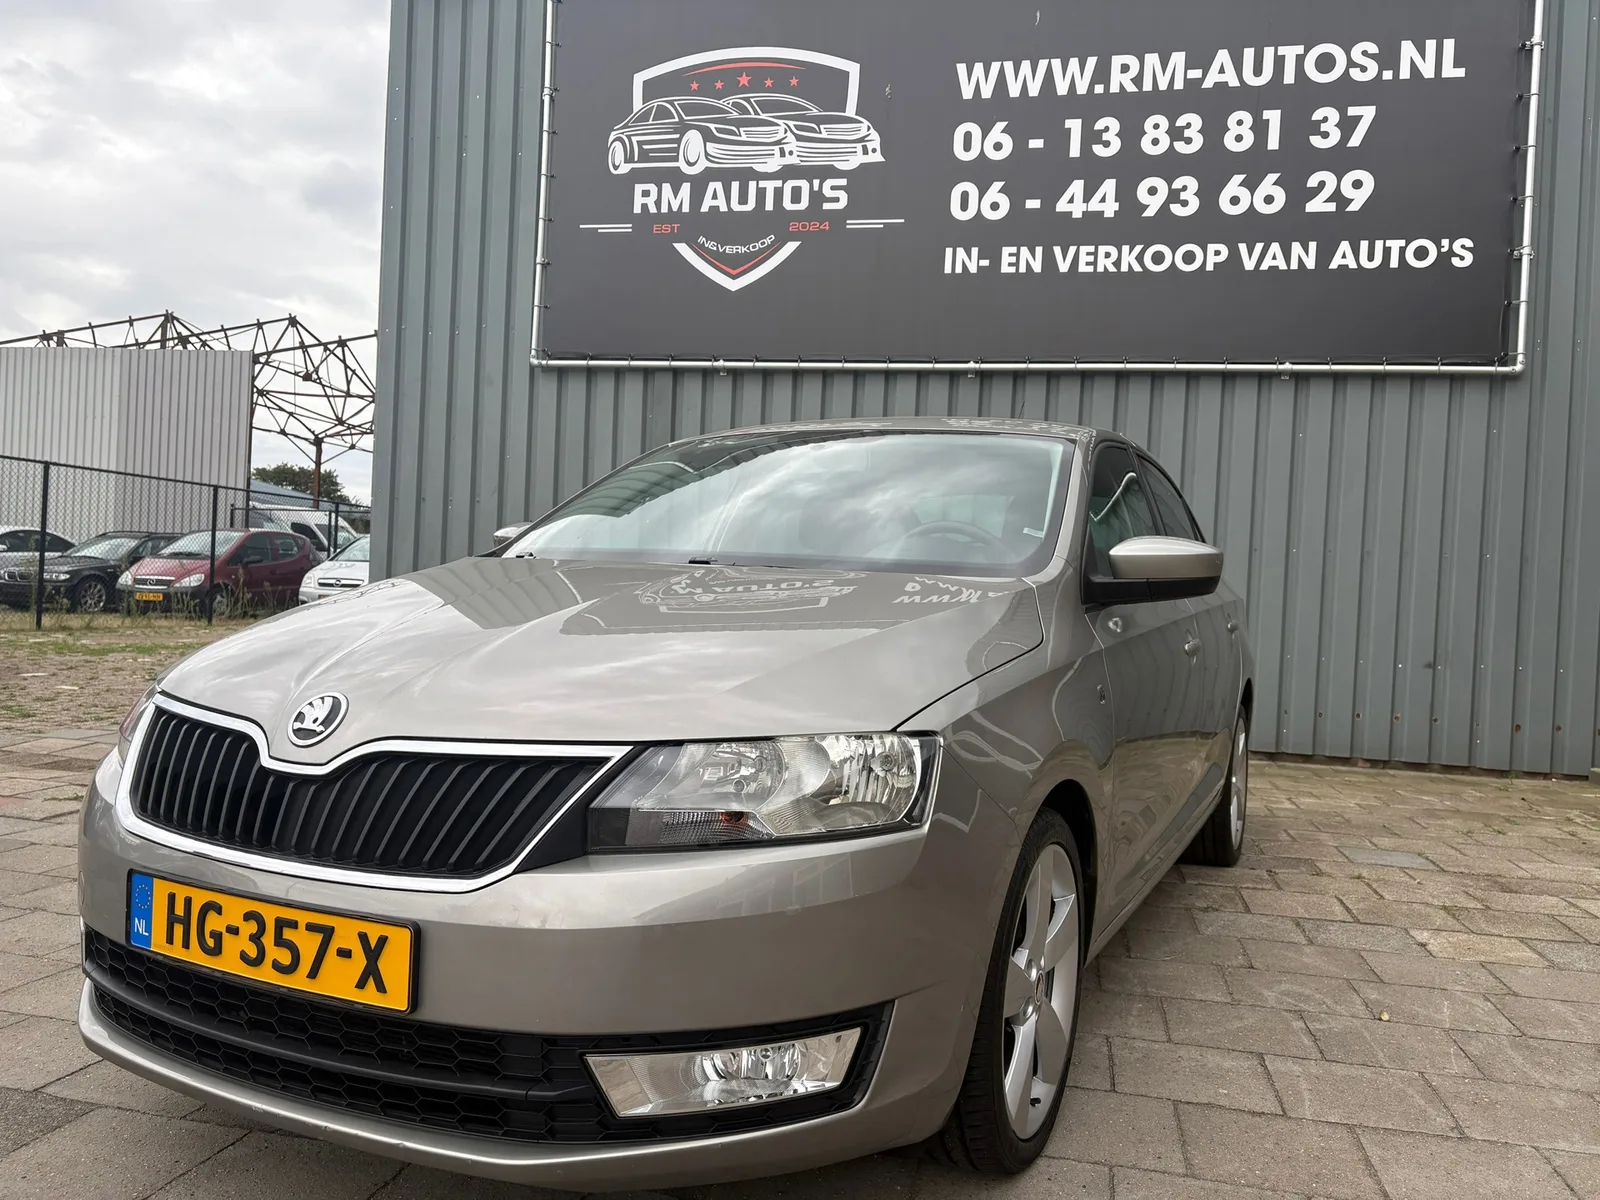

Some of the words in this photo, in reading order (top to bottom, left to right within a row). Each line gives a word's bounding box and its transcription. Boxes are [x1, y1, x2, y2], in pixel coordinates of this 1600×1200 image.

[956, 38, 1466, 100] WWW.RM-AUTOS.NL
[953, 121, 1013, 162] 06
[1064, 116, 1122, 158] 13
[1140, 112, 1204, 156] 83
[1223, 109, 1282, 153] 81
[1308, 105, 1377, 149] 37
[633, 182, 691, 214] RM
[700, 178, 849, 213] AUTO'S
[950, 181, 1011, 221] 06
[1055, 178, 1120, 218] 44
[1136, 175, 1200, 217] 93
[1218, 172, 1287, 216] 66
[1305, 169, 1375, 213] 29
[653, 223, 681, 234] EST
[788, 221, 830, 233] 2024
[697, 234, 776, 254] IN&VERKOOP
[944, 246, 990, 274] IN-
[1001, 245, 1043, 273] EN
[1053, 243, 1229, 273] VERKOOP
[1238, 241, 1317, 271] VAN
[134, 917, 149, 936] NL
[165, 891, 389, 994] HG-357-X
